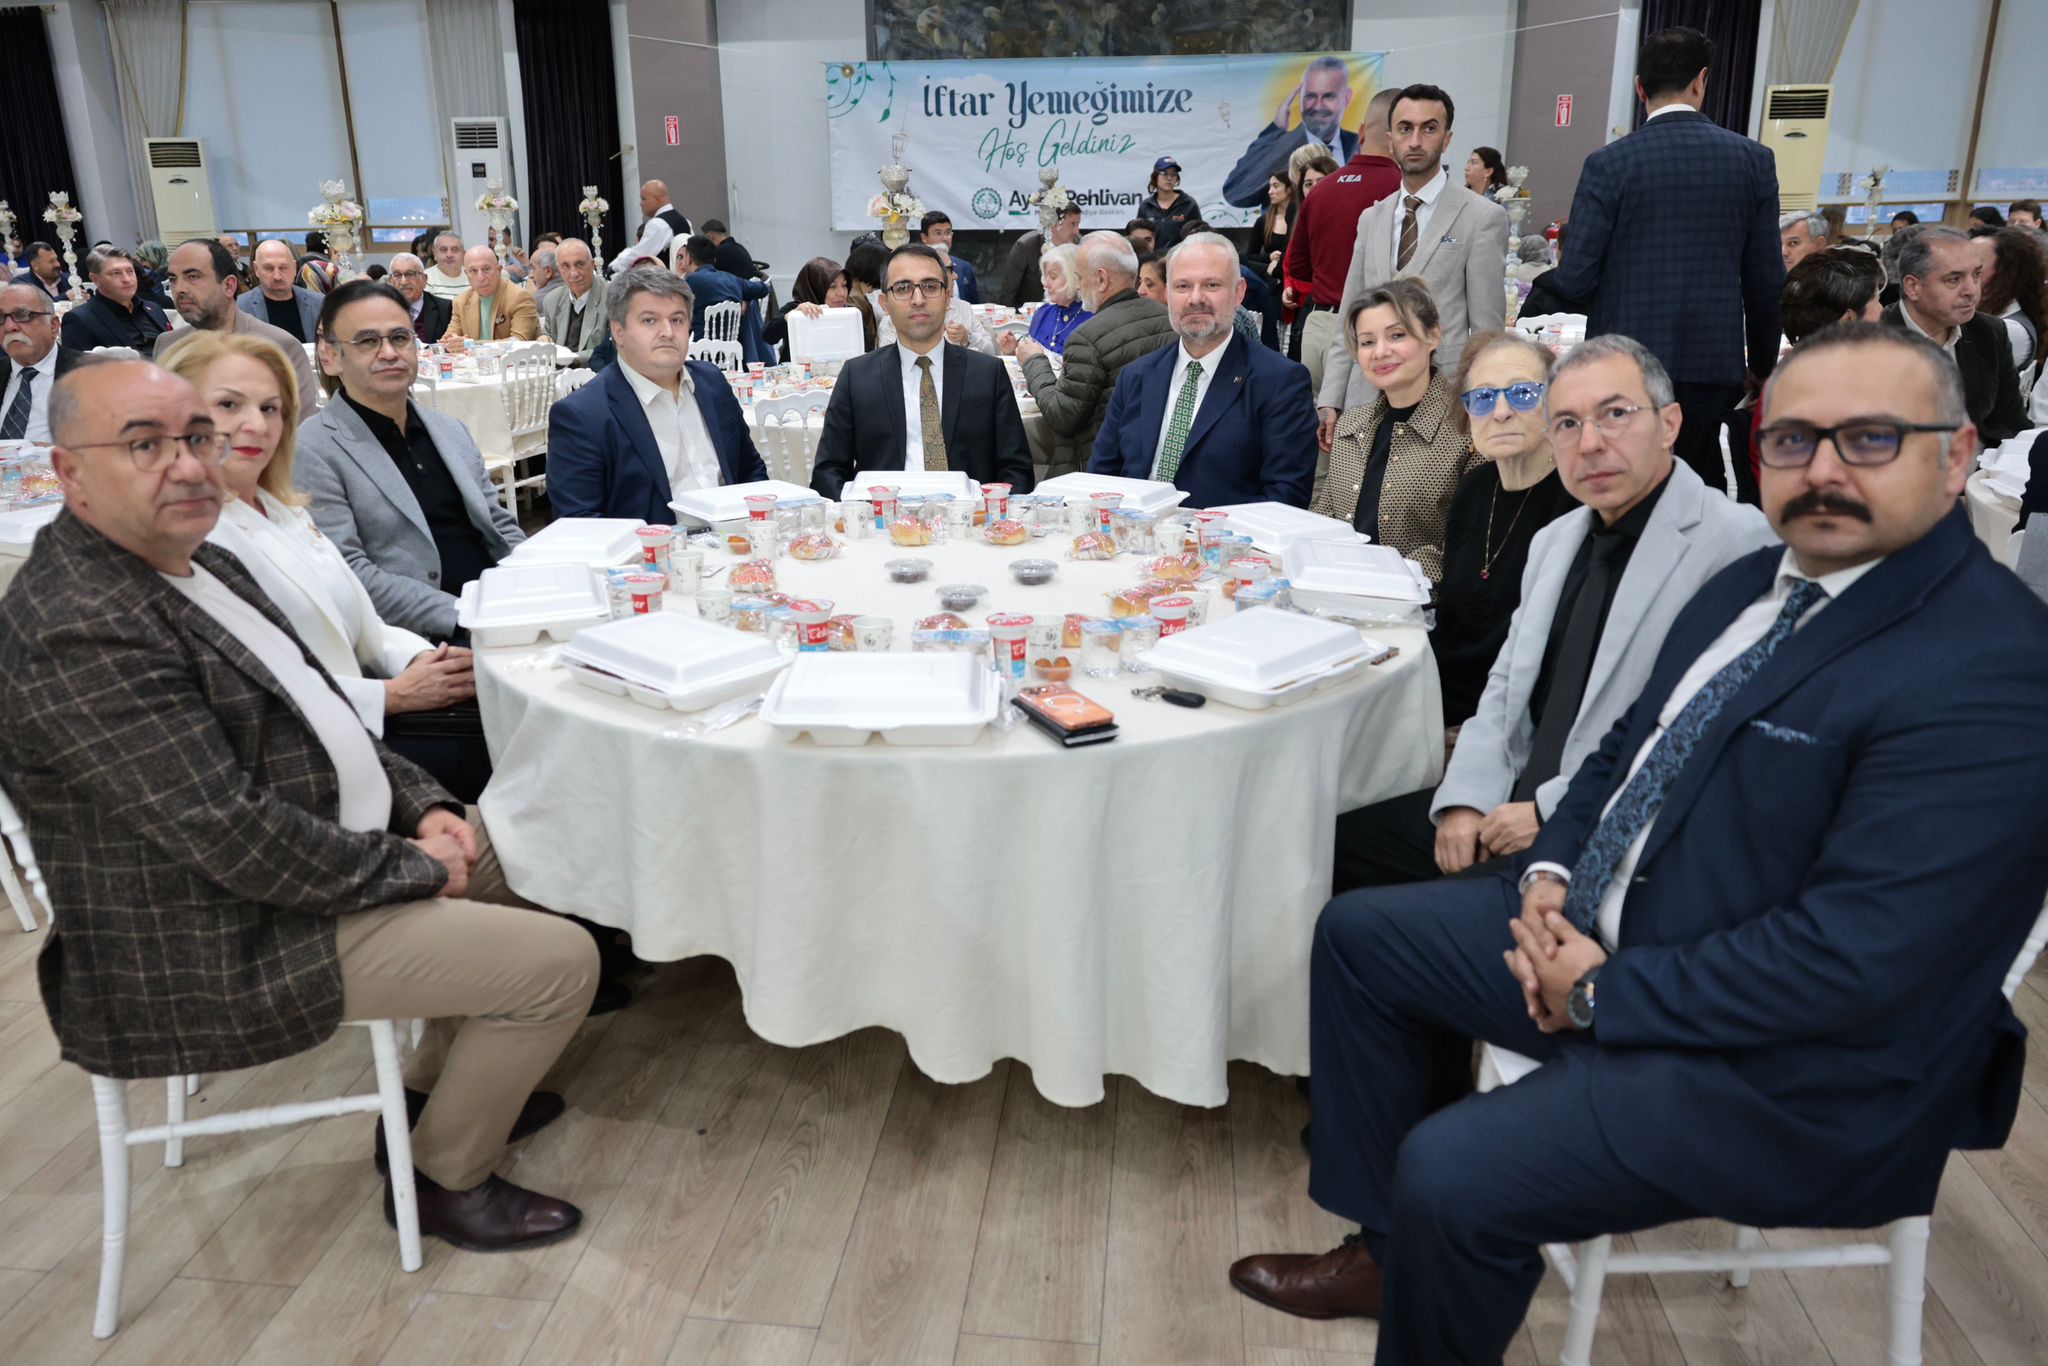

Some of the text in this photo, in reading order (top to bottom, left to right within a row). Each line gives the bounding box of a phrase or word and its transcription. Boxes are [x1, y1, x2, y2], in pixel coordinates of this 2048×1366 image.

[923, 75, 1193, 129] İftar Yemeğimize
[978, 118, 1136, 173] Hoş Geldiniz
[1337, 174, 1362, 183] KEA
[1066, 189, 1143, 206] Pehlivan
